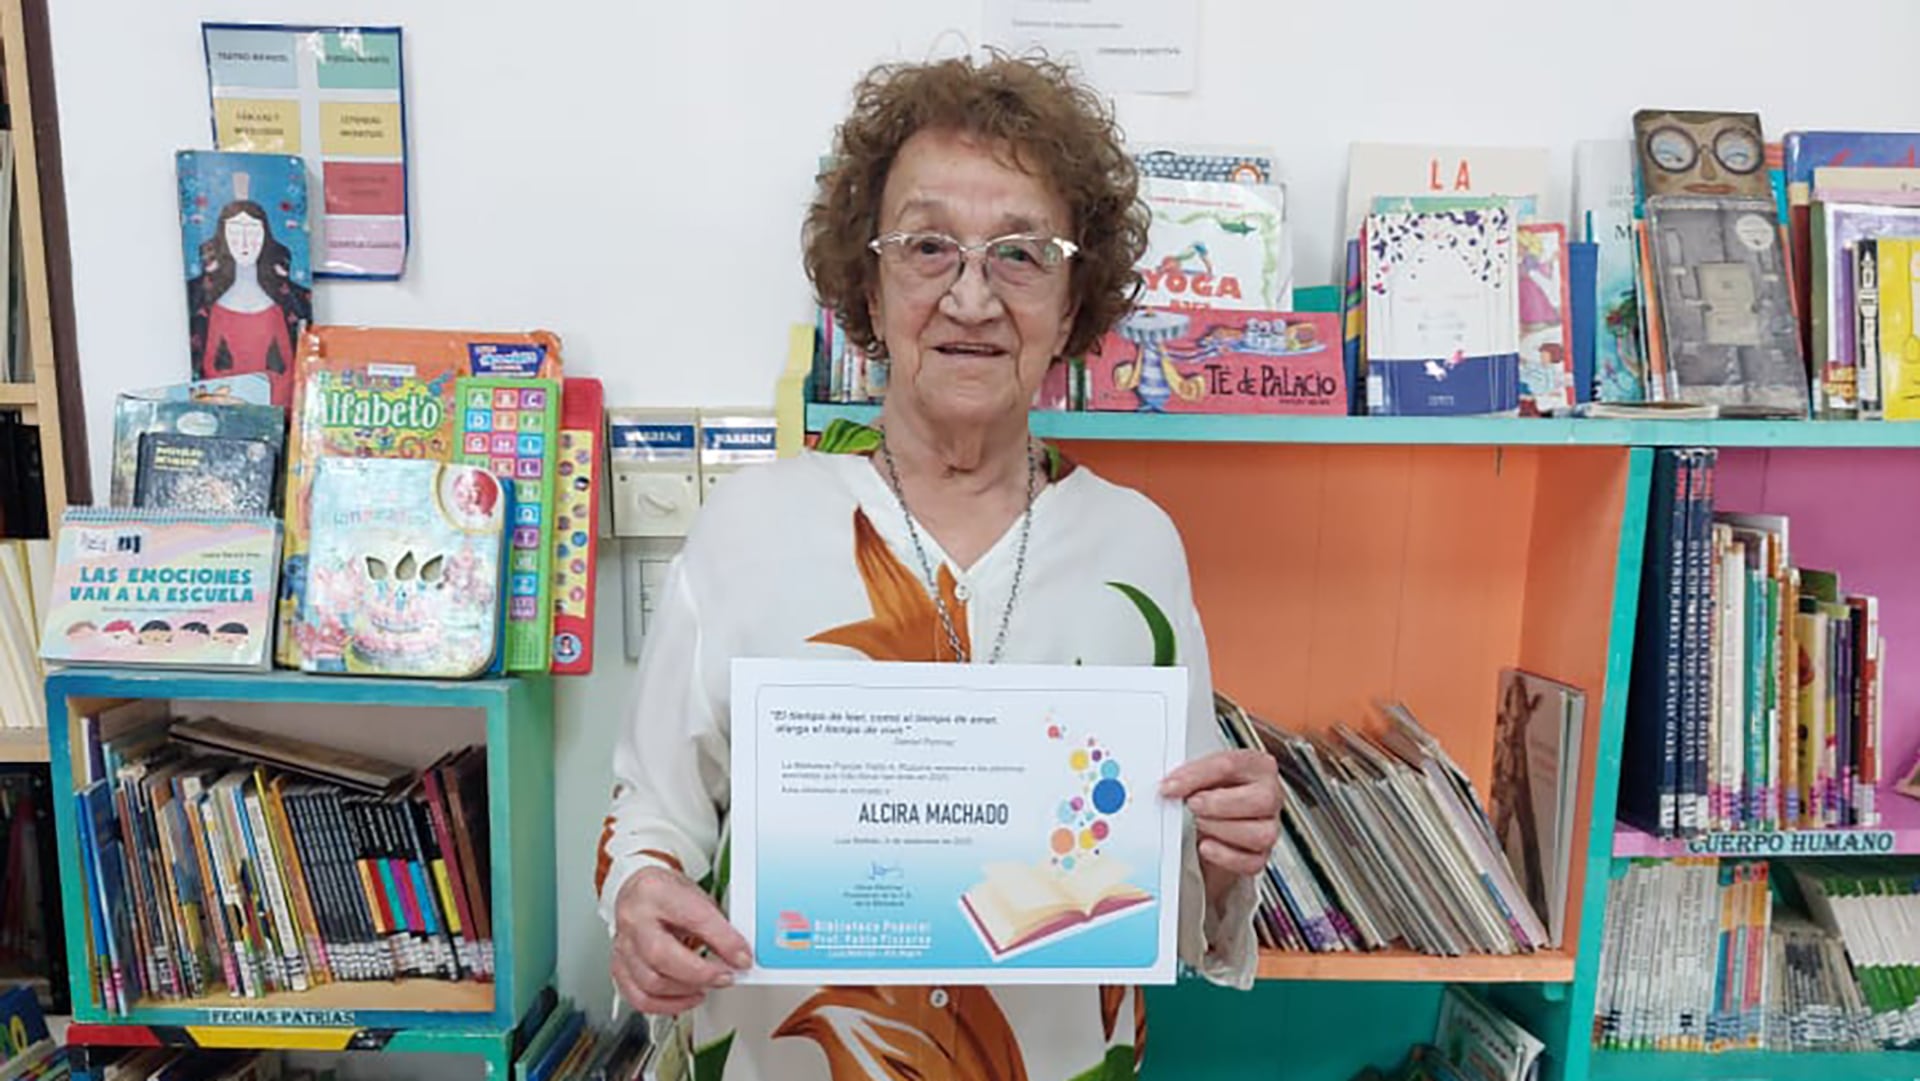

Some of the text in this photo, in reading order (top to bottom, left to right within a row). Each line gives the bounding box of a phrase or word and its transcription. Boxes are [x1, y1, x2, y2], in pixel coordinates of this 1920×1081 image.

[1429, 159, 1472, 191] LA
[1140, 268, 1243, 300] YOGA
[80, 566, 253, 585] LAS EMOCIONES
[69, 586, 254, 603] VAN A LA ESCUELA
[859, 802, 1009, 825] ALCIRA MACHADO
[1689, 832, 1894, 853] CUERPO HUMANO
[211, 1009, 355, 1025] FECHAS PATRIAS
